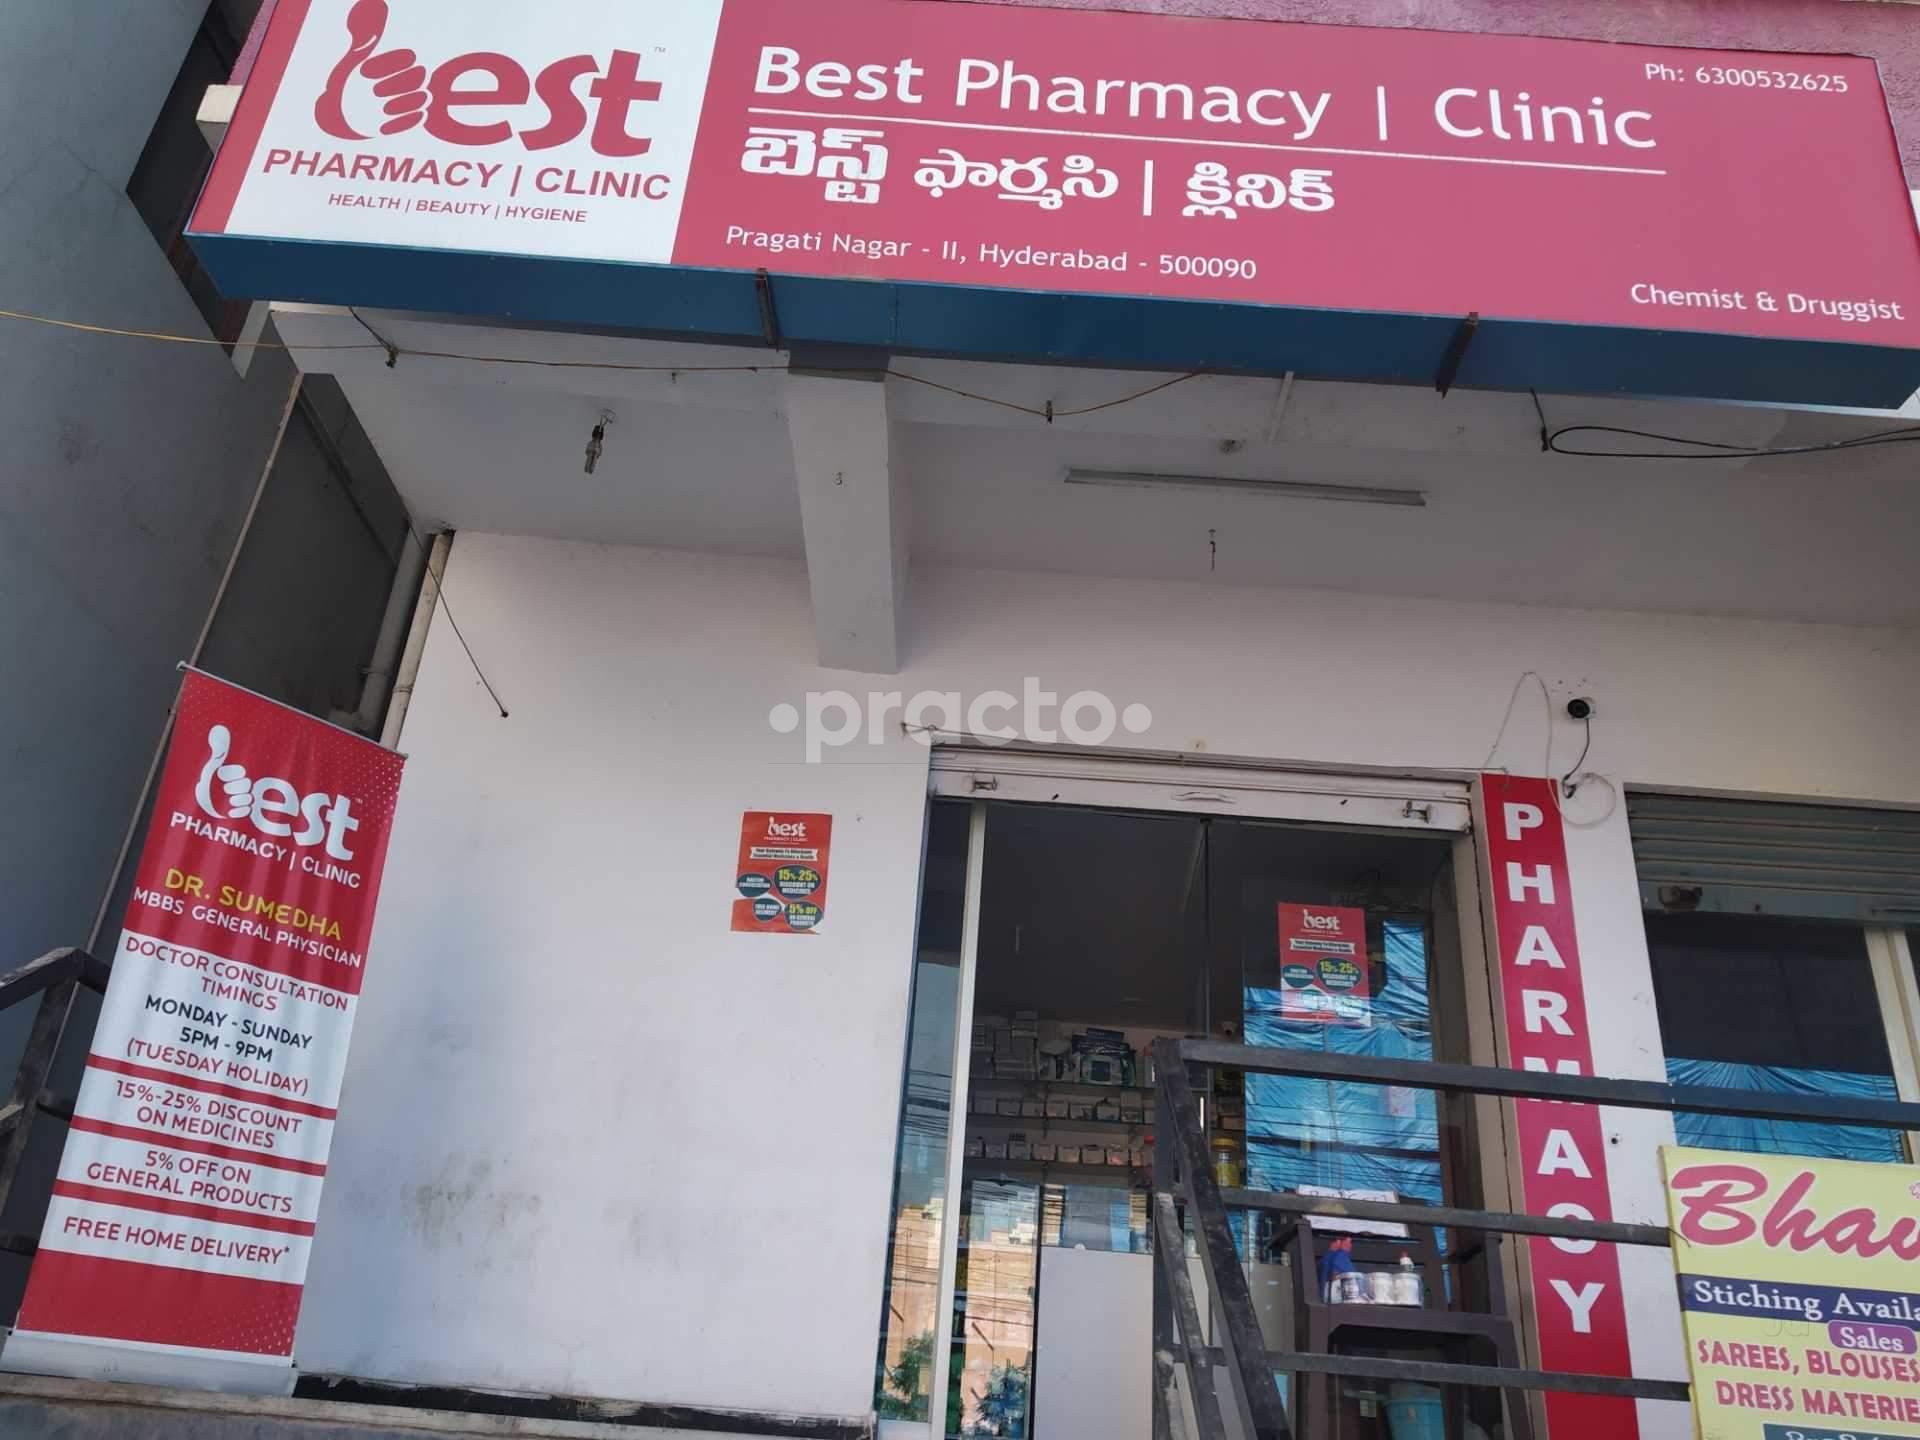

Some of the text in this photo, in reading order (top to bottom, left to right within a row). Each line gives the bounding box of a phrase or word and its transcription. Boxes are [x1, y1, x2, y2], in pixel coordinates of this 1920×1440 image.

[753, 46, 925, 104] Best
[956, 58, 1332, 140] Pharmacy
[1435, 87, 1657, 148] Clinic
[1645, 63, 1849, 93] Ph: 6300532625
[262, 148, 503, 190] PHARMACY
[534, 167, 671, 201] CLINIC
[740, 127, 888, 205] బెస్ట్
[913, 148, 1119, 211] ఫార్మసి
[1181, 161, 1335, 220] క్లినిక్
[328, 193, 401, 211] HEALTH
[415, 199, 491, 217] BEAUTY
[505, 205, 588, 223] HYGIENE
[725, 225, 823, 254] Pragati
[831, 234, 912, 260] Nagar
[979, 244, 1128, 272] Hyderabad
[1159, 255, 1257, 280] 500090
[1631, 283, 1905, 323] Chemist & Druggist
[170, 811, 288, 862] PHARMACY
[301, 855, 361, 888] CLINIC
[134, 886, 361, 968] MBBS GENERAL PHYSICIAN
[164, 868, 342, 940] DR. SUMEDHA
[126, 936, 349, 1011] DOCTOR CONSULTATION
[201, 977, 278, 1011] TIMINGS
[145, 994, 228, 1027] MONDAY
[241, 1019, 313, 1049] SUNDAY
[179, 1027, 219, 1050] 5PM
[235, 1040, 273, 1063] 9PM
[127, 1037, 309, 1097] (TUESDAY HOLIDAY)
[116, 1079, 303, 1134] 15%-25% DISCOUNT
[137, 1106, 276, 1148] ON MEDICINES
[87, 1162, 293, 1213] GENERAL PRODUCTS
[145, 1150, 252, 1184] 5% OFF ON
[64, 1216, 121, 1241] FREE
[125, 1225, 195, 1251] HOME
[1694, 1280, 1824, 1321] Stiching
[1698, 1339, 1920, 1383] SAREES, BLOUSES
[1840, 1327, 1905, 1352] Sales
[1715, 1380, 1795, 1411] DRESS
